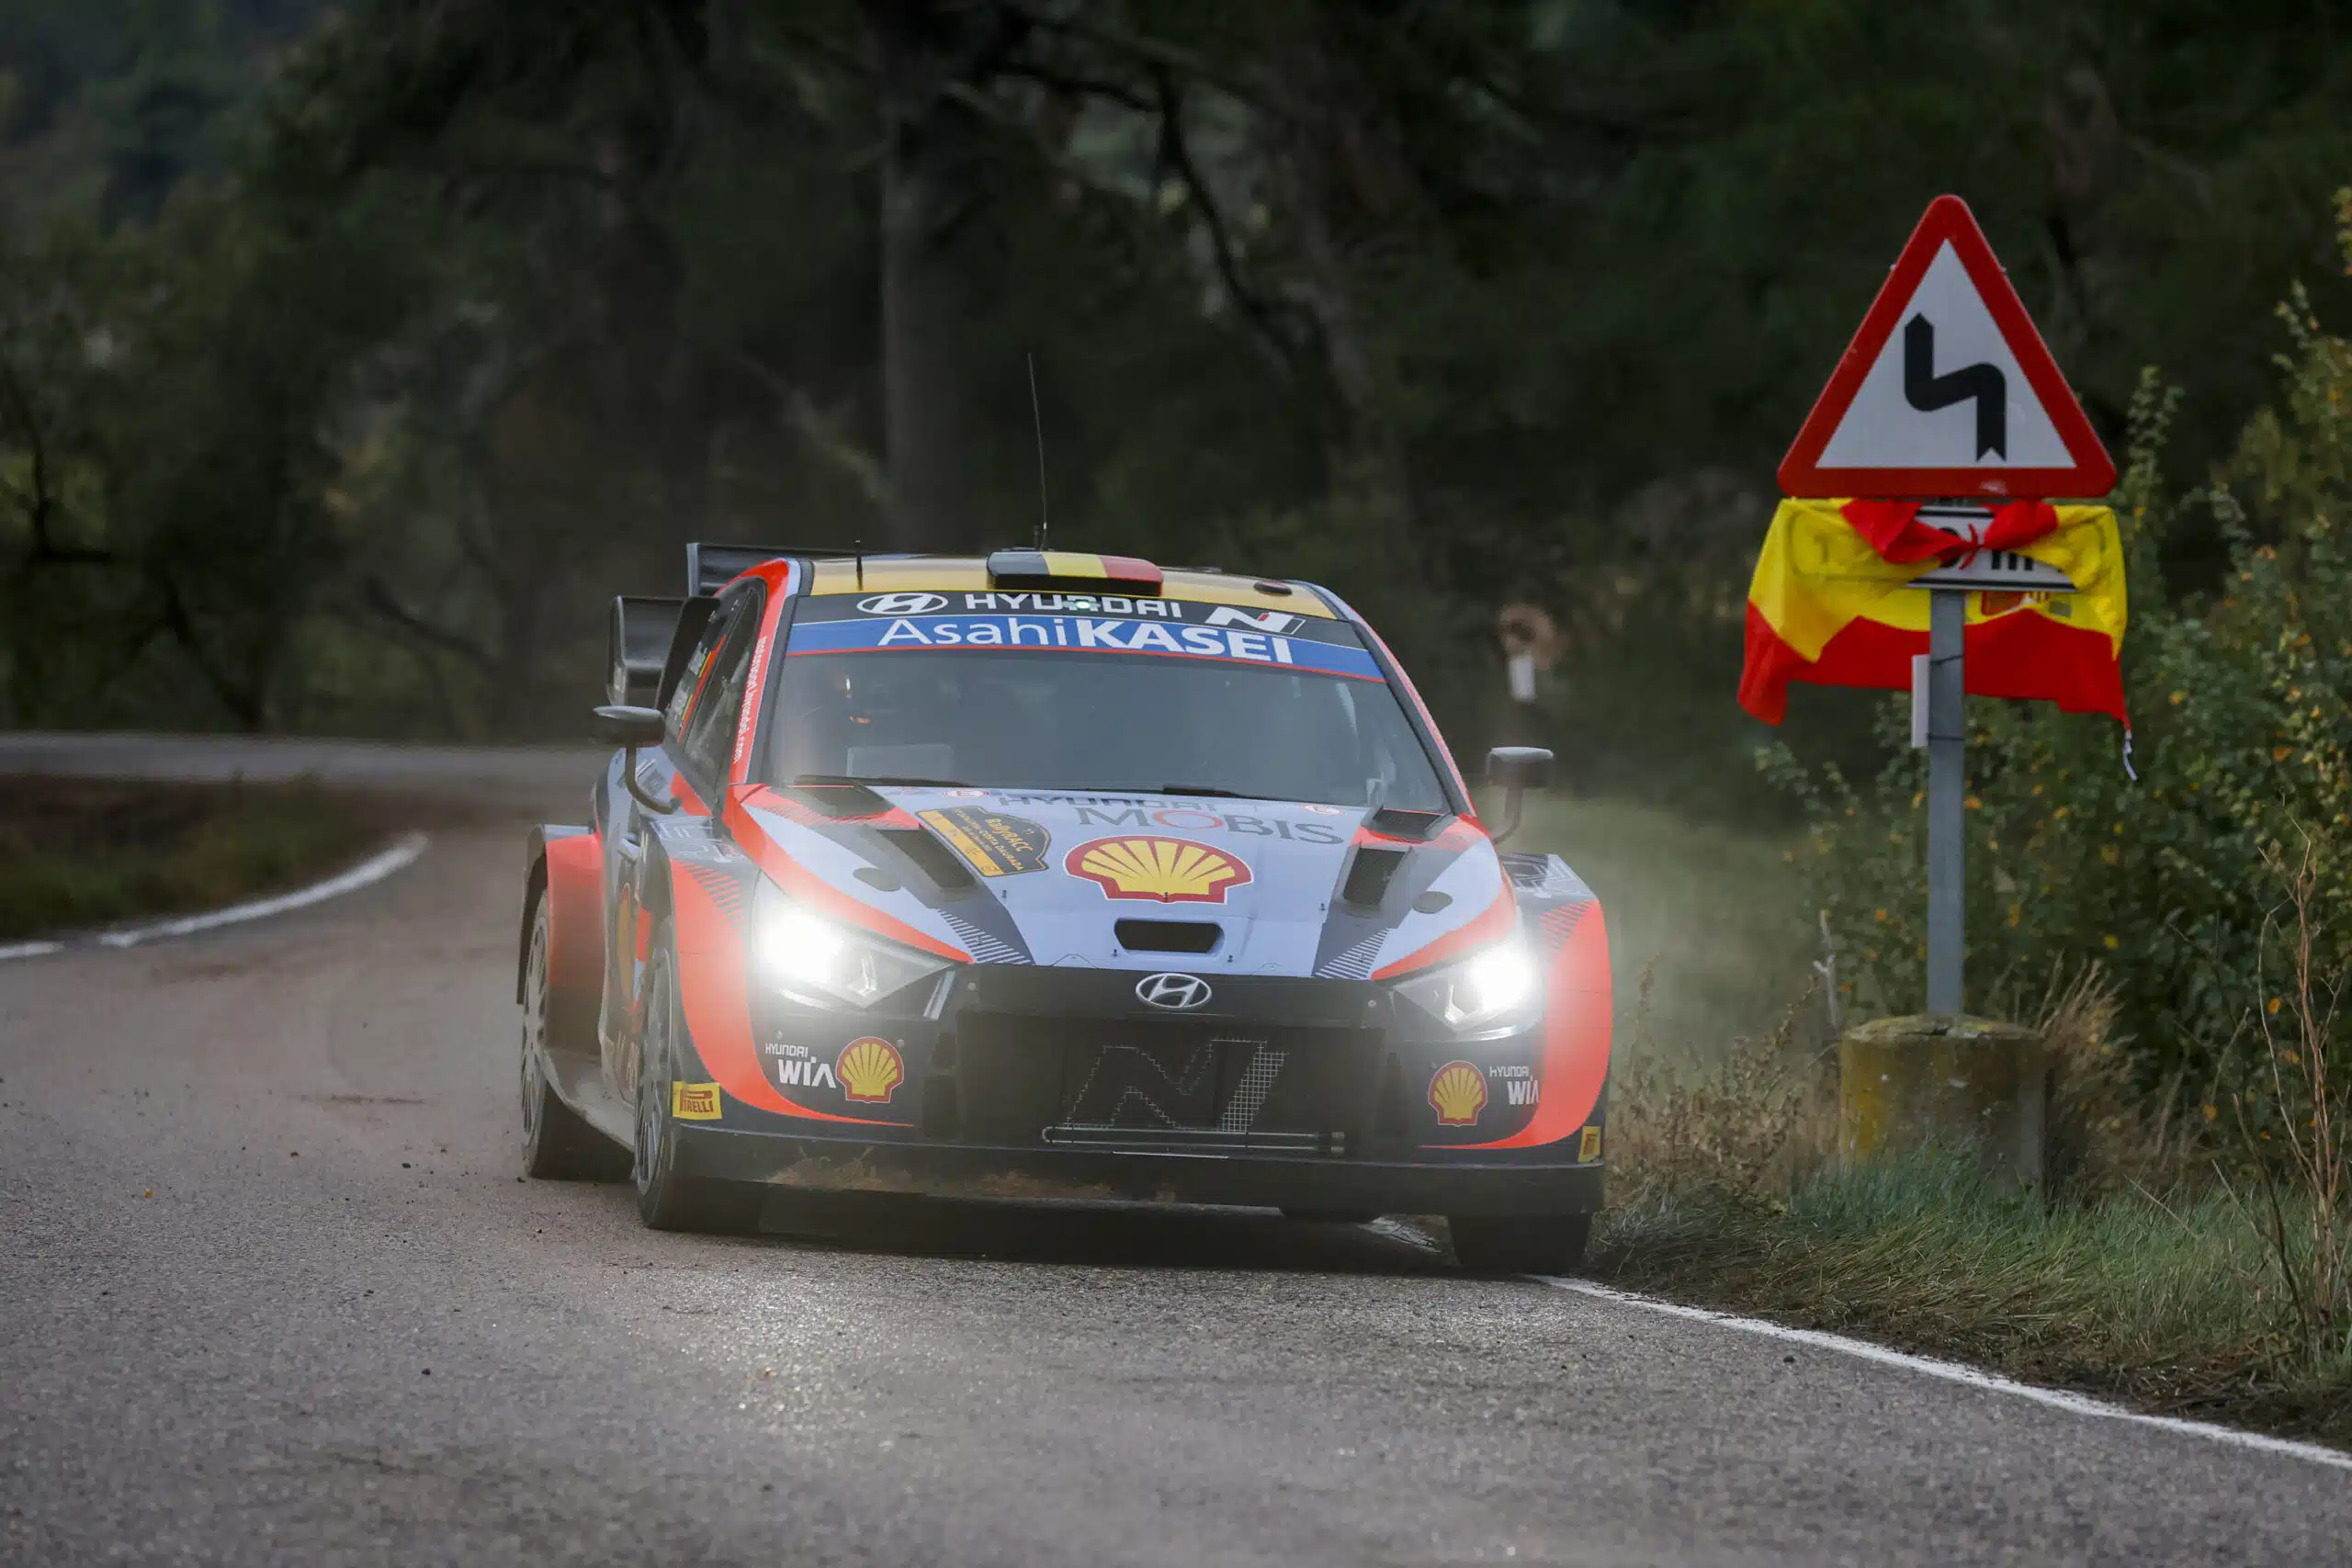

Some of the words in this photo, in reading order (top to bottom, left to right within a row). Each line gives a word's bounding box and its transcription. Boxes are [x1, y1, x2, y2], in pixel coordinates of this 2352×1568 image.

[966, 593, 1182, 618] HYUNDAI
[1073, 807, 1344, 845] MOBIS
[764, 1043, 809, 1058] HYUNDAI
